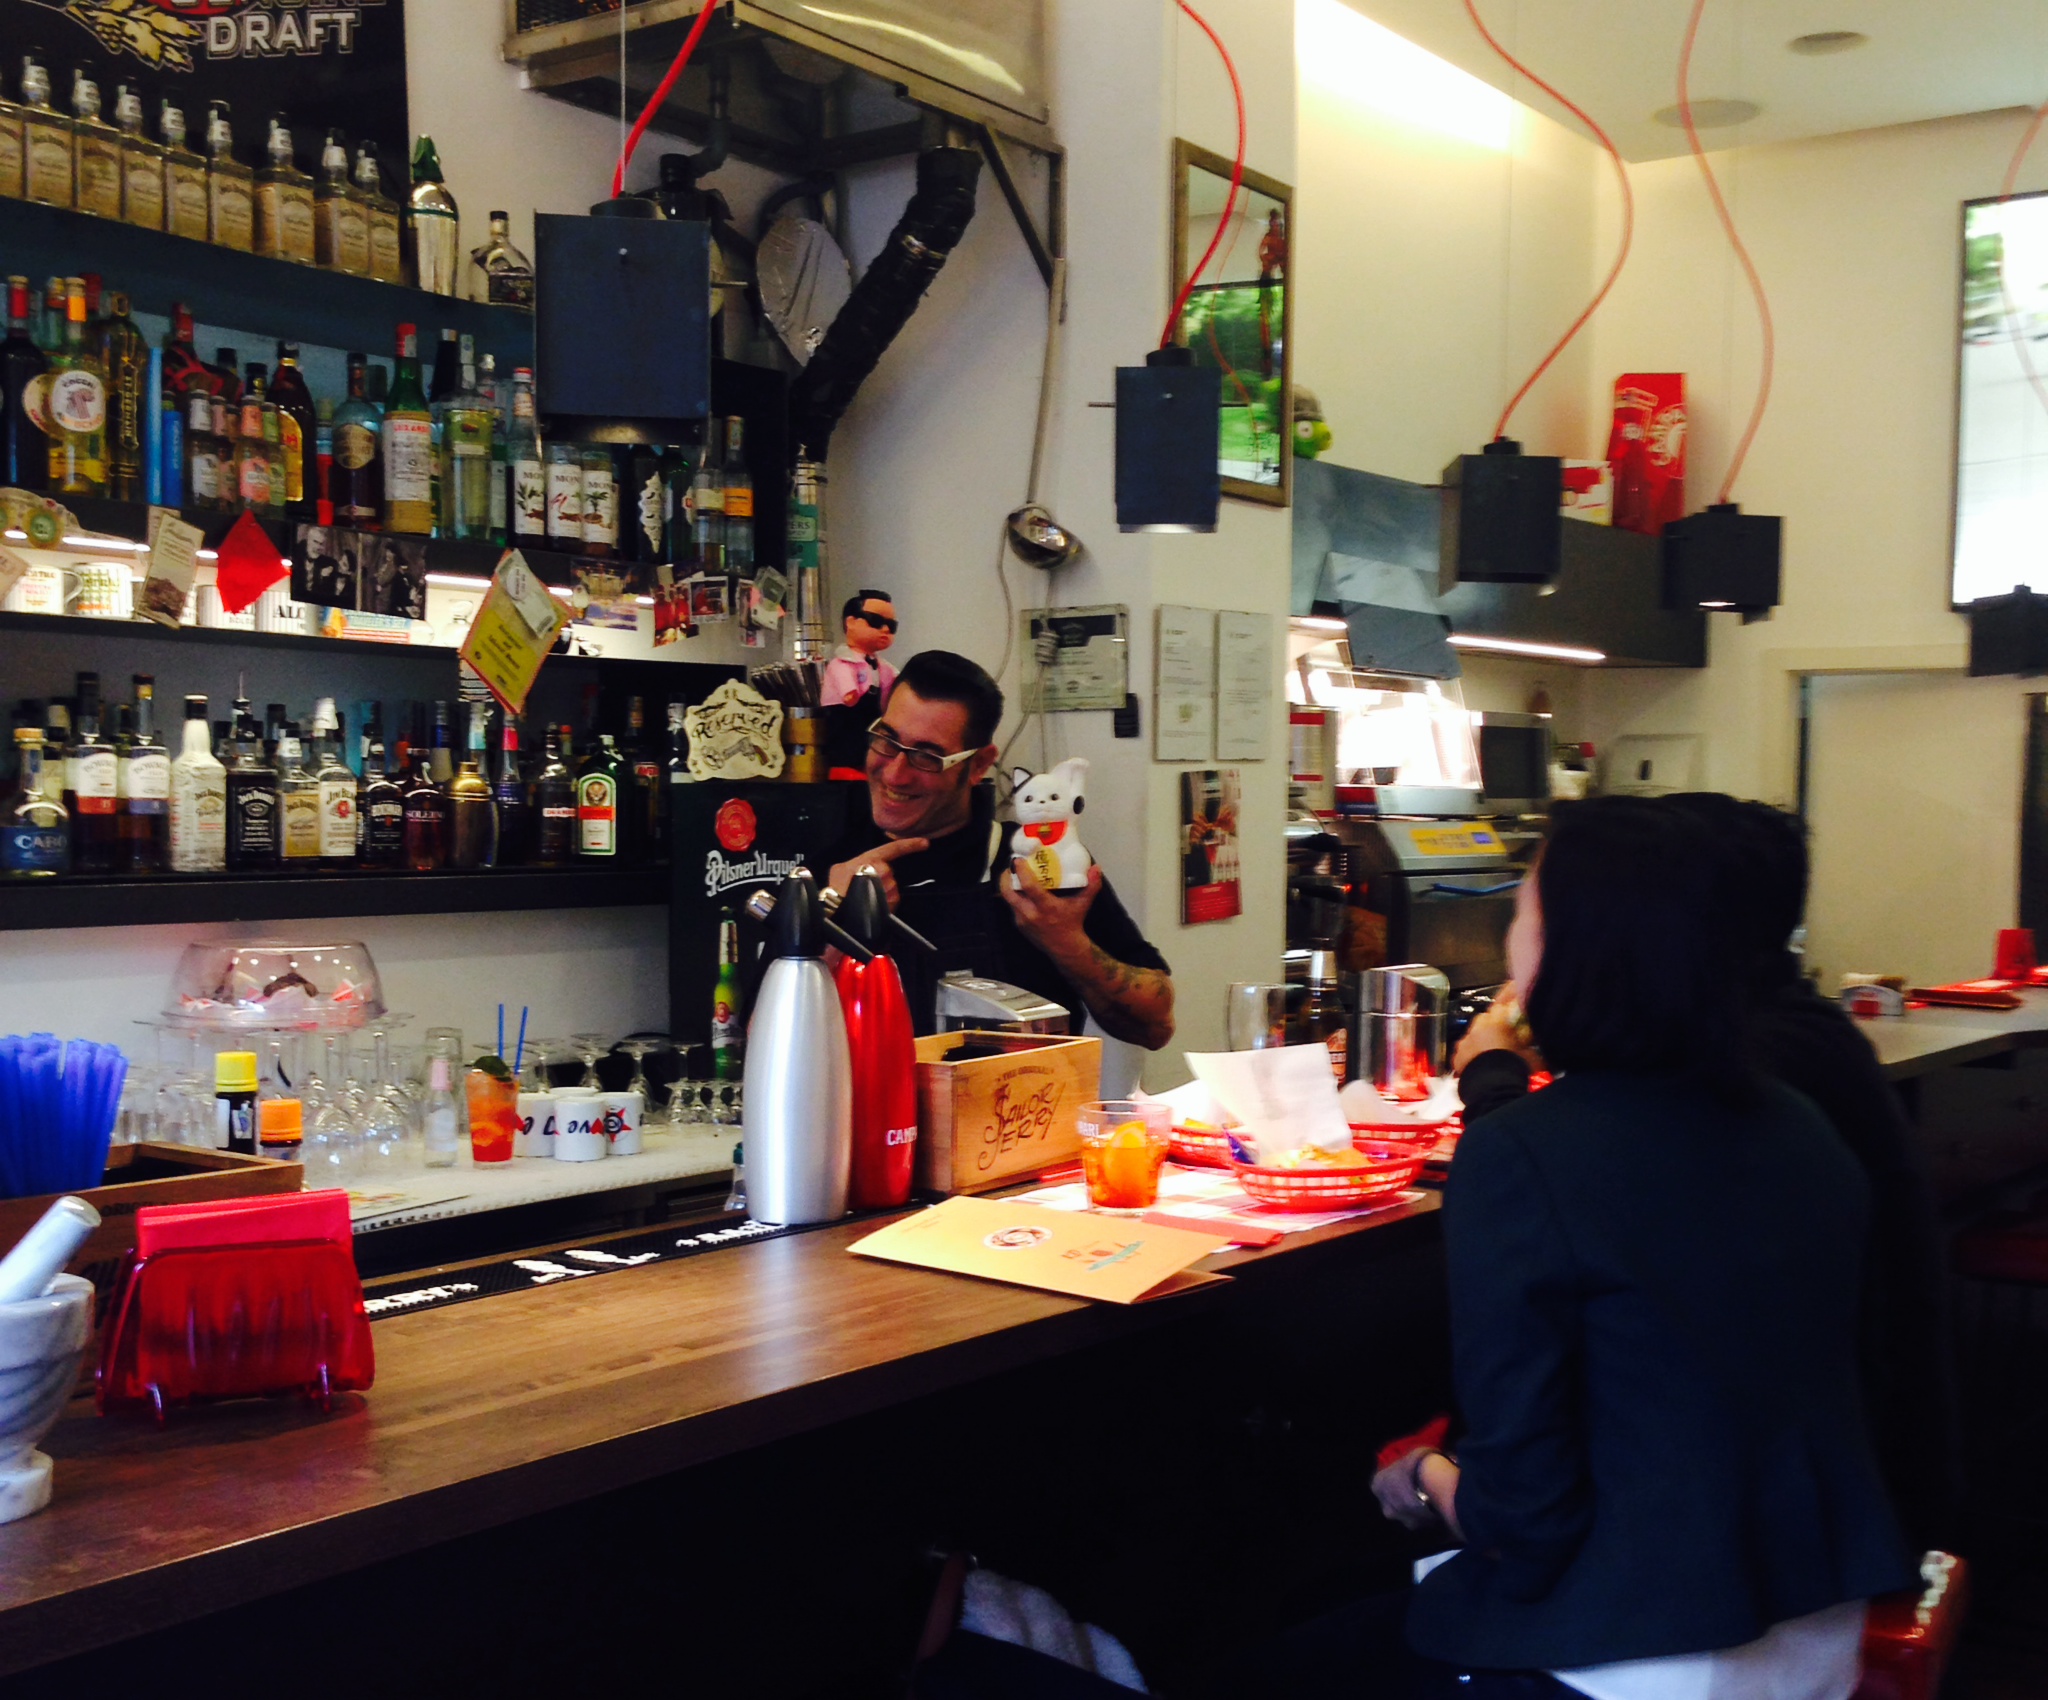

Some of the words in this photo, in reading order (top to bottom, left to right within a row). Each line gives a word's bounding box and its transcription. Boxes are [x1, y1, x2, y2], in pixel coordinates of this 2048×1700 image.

[208, 11, 357, 56] DRAFT
[692, 712, 778, 742] Reserved
[704, 850, 757, 897] Pilsner
